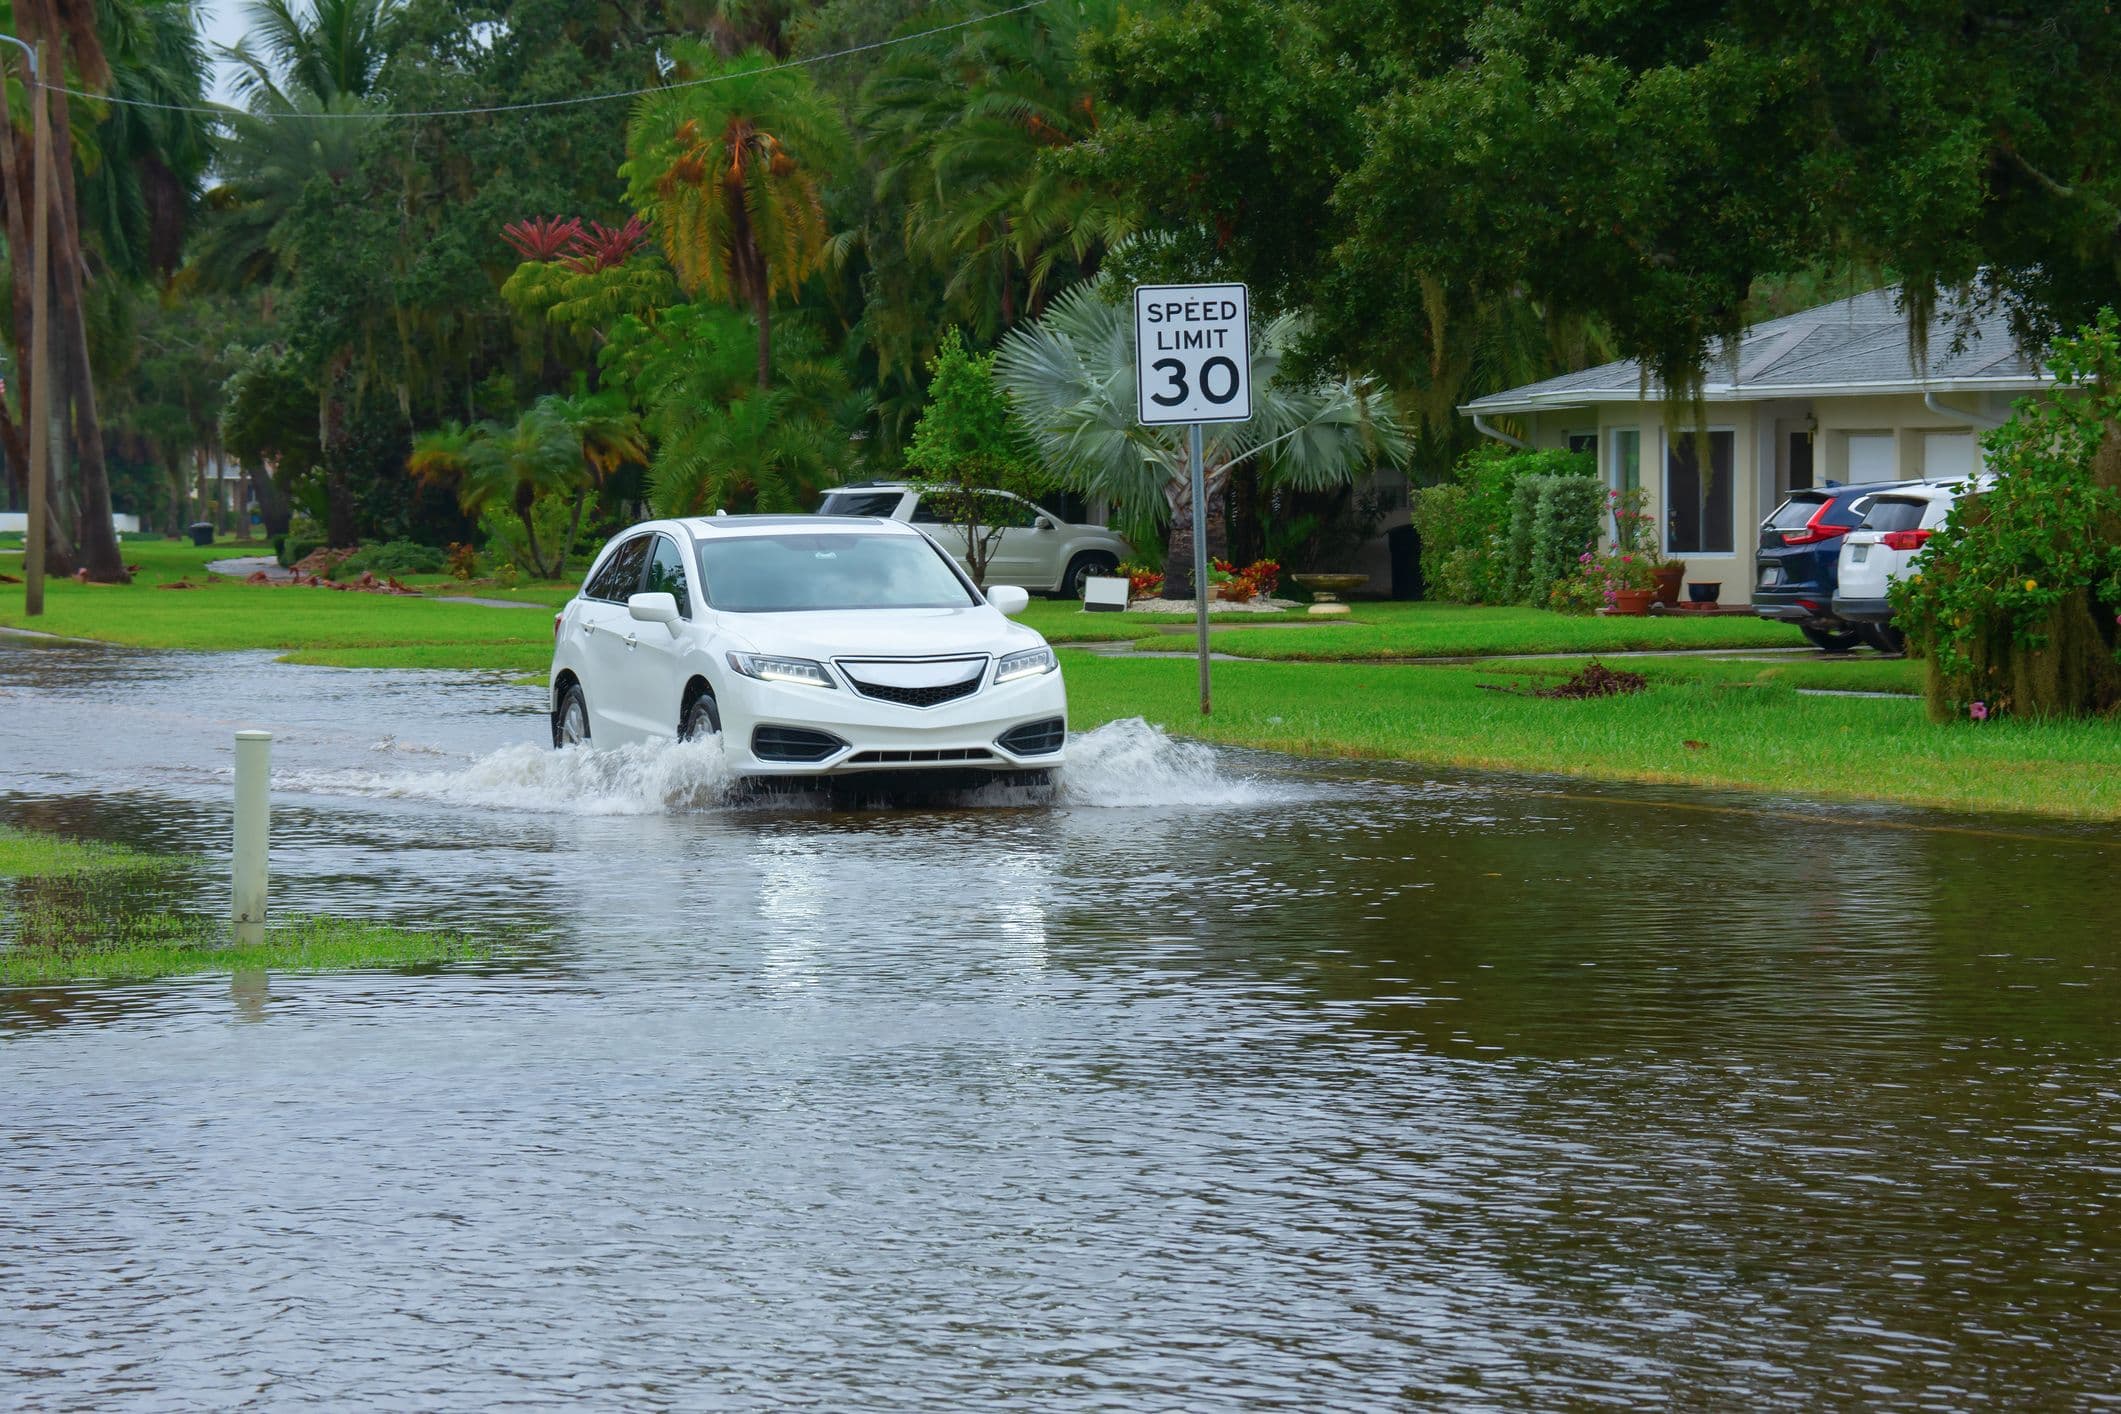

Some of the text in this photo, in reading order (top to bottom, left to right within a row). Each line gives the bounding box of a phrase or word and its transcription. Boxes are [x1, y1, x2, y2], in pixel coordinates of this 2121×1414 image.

[1147, 301, 1237, 323] SPEED
[1157, 329, 1228, 350] LIMIT
[1150, 356, 1240, 407] 30
